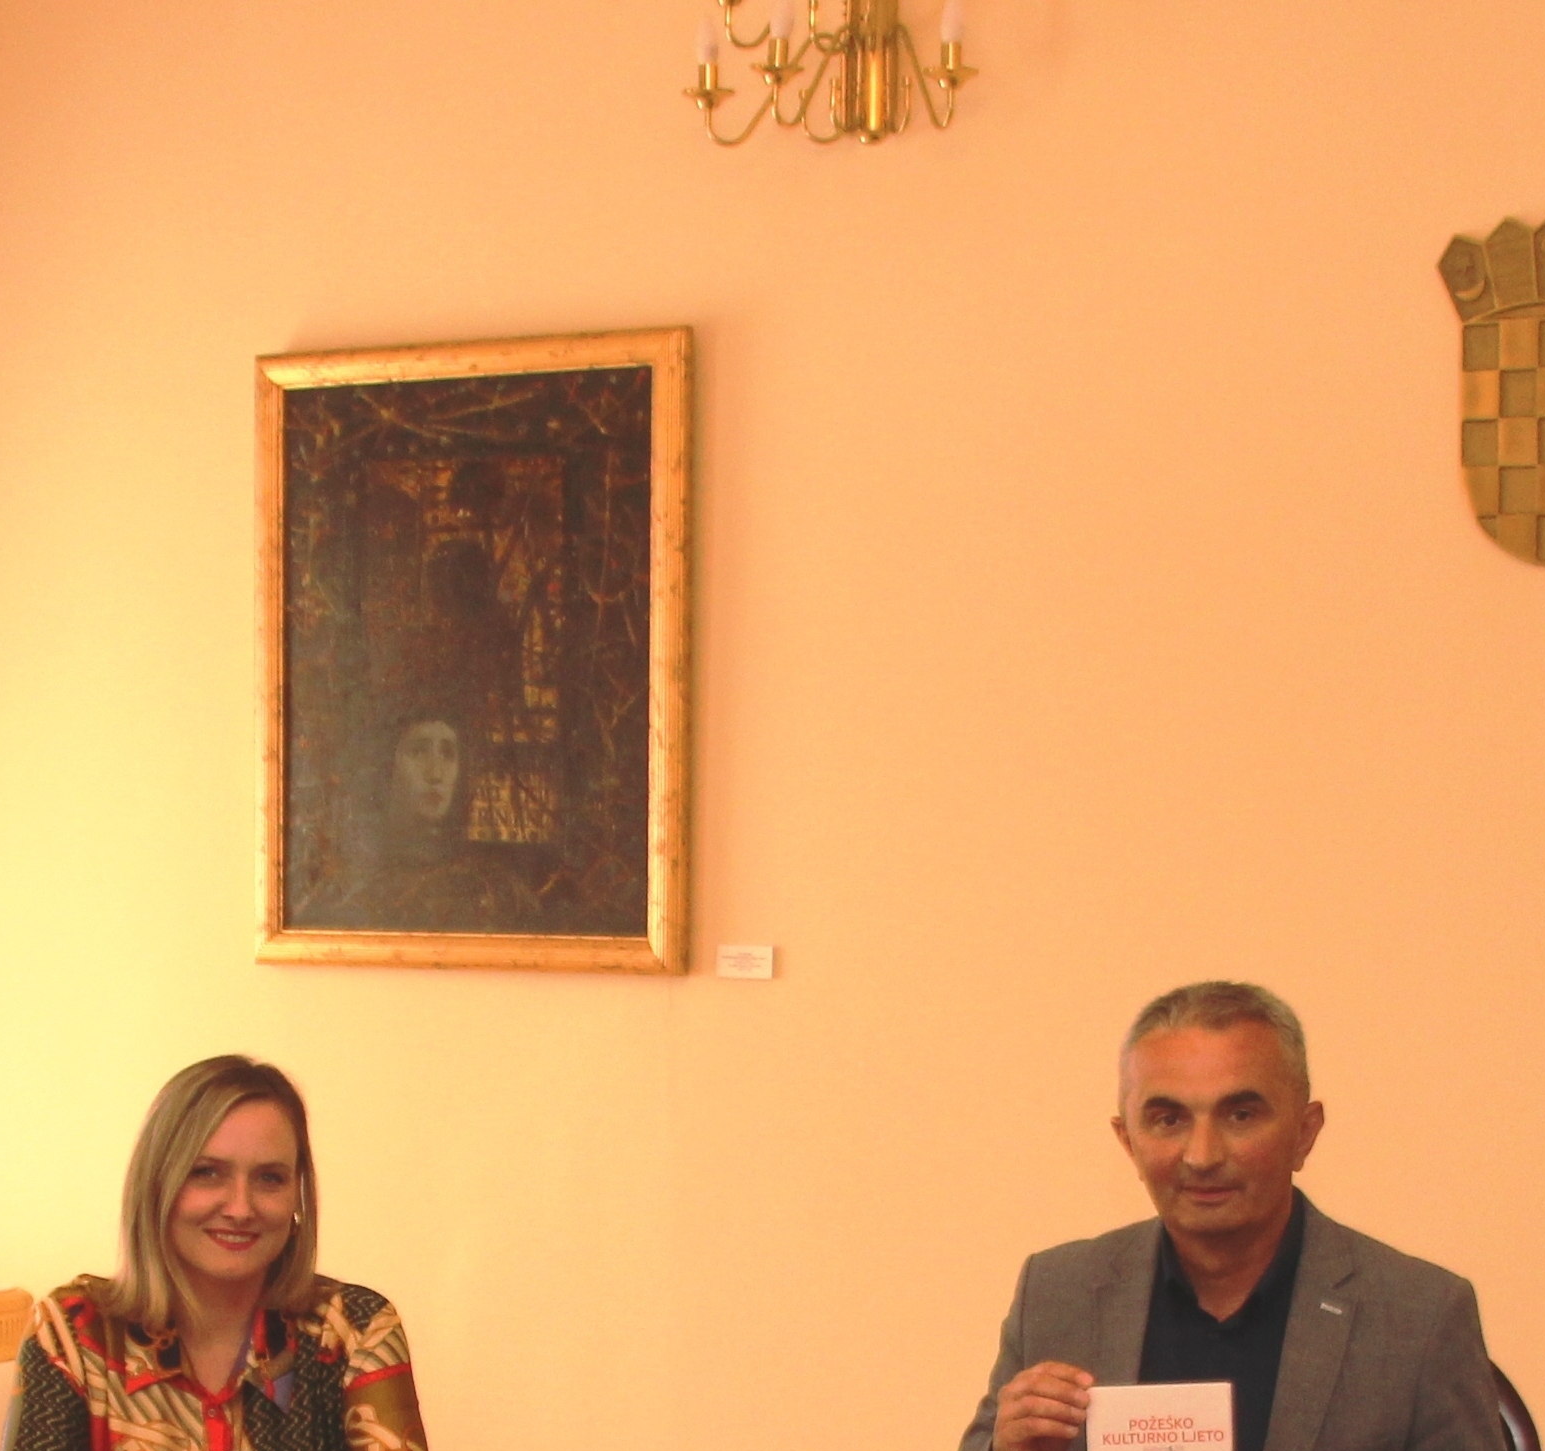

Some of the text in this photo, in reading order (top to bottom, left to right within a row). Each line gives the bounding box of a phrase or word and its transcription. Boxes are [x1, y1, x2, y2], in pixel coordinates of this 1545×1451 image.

[1129, 1416, 1193, 1430] POŽEŠKO
[1103, 1431, 1223, 1445] KULTURNO LJETO
